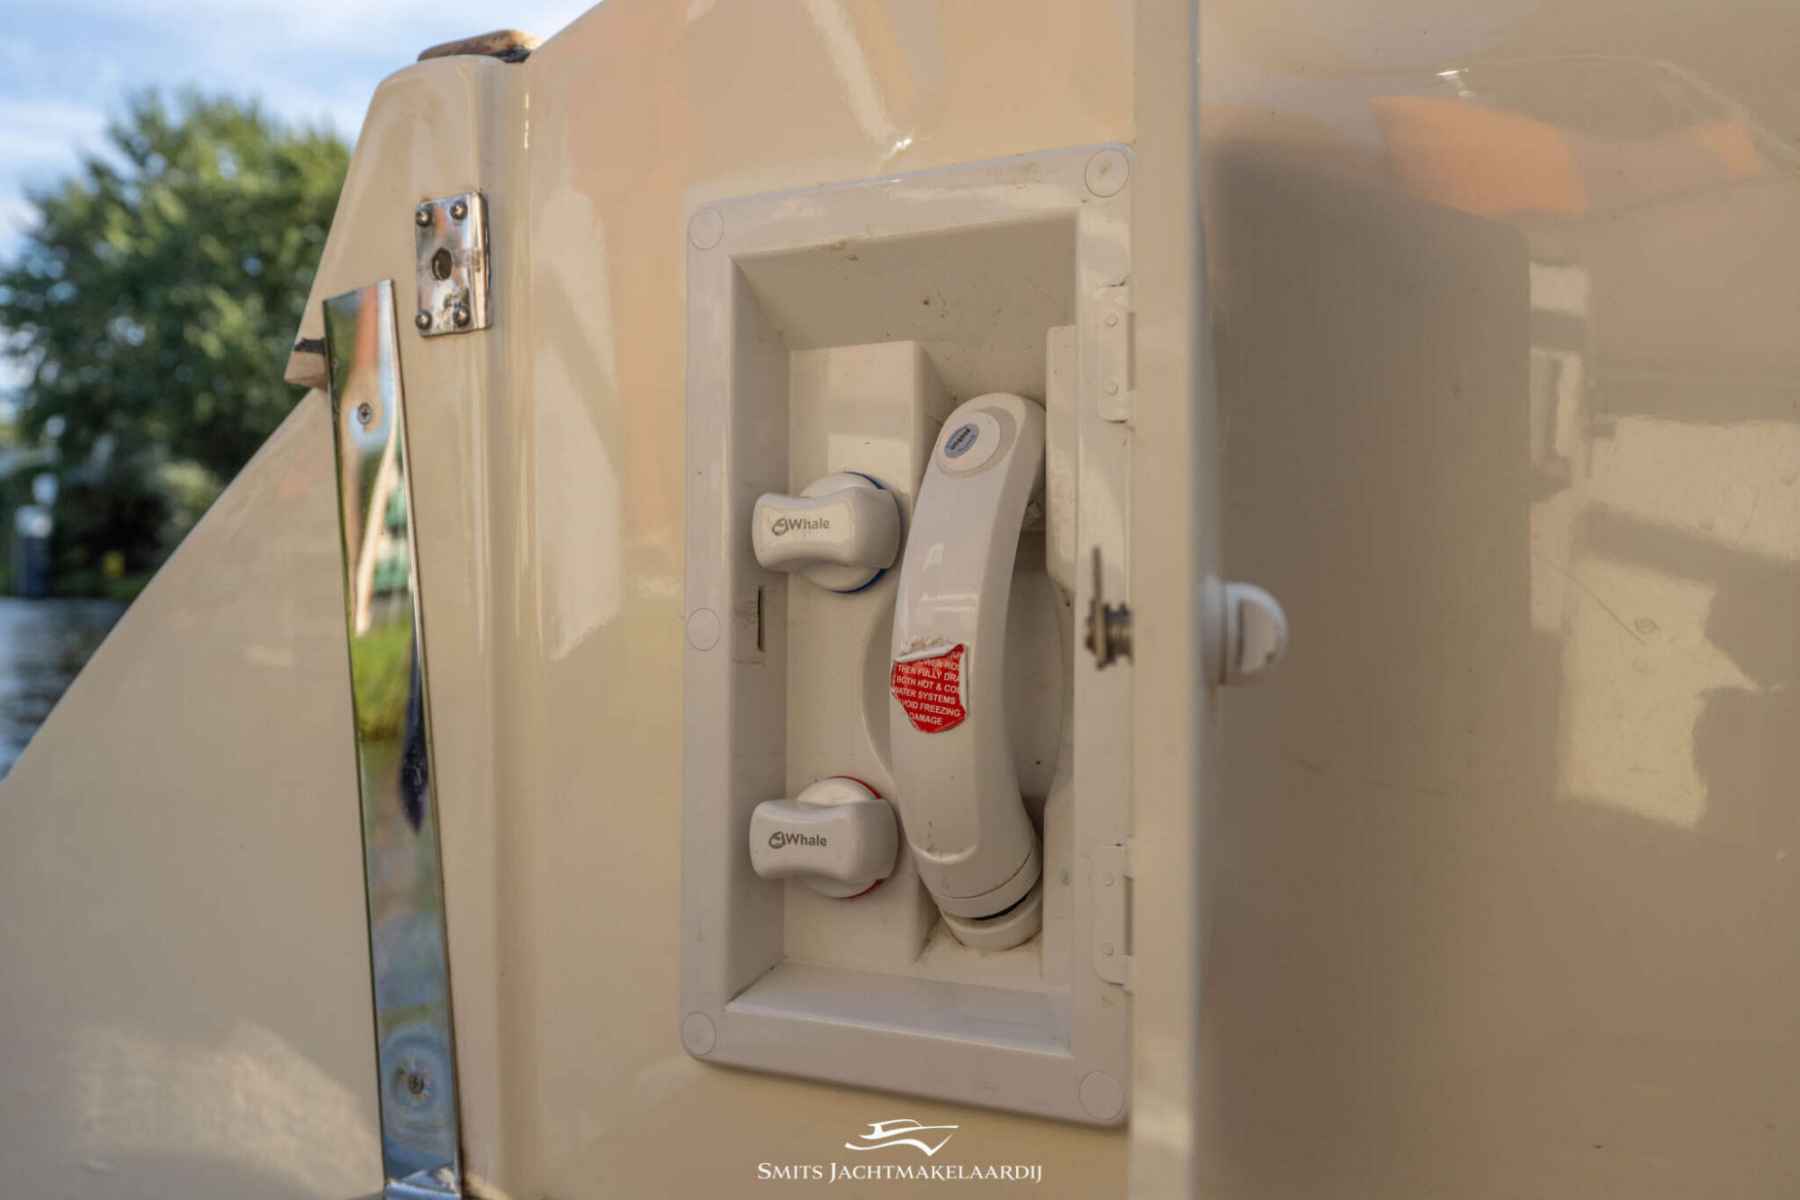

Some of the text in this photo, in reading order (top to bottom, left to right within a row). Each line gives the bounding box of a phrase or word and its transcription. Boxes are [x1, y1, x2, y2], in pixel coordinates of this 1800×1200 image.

[788, 517, 831, 530] Whale
[918, 668, 943, 679] FULLY
[896, 675, 916, 686] BOTH
[917, 678, 934, 689] HOT
[935, 683, 942, 692] &
[918, 690, 956, 704] SYSTEMS
[919, 702, 961, 717] FREEZING
[785, 832, 828, 847] Whale
